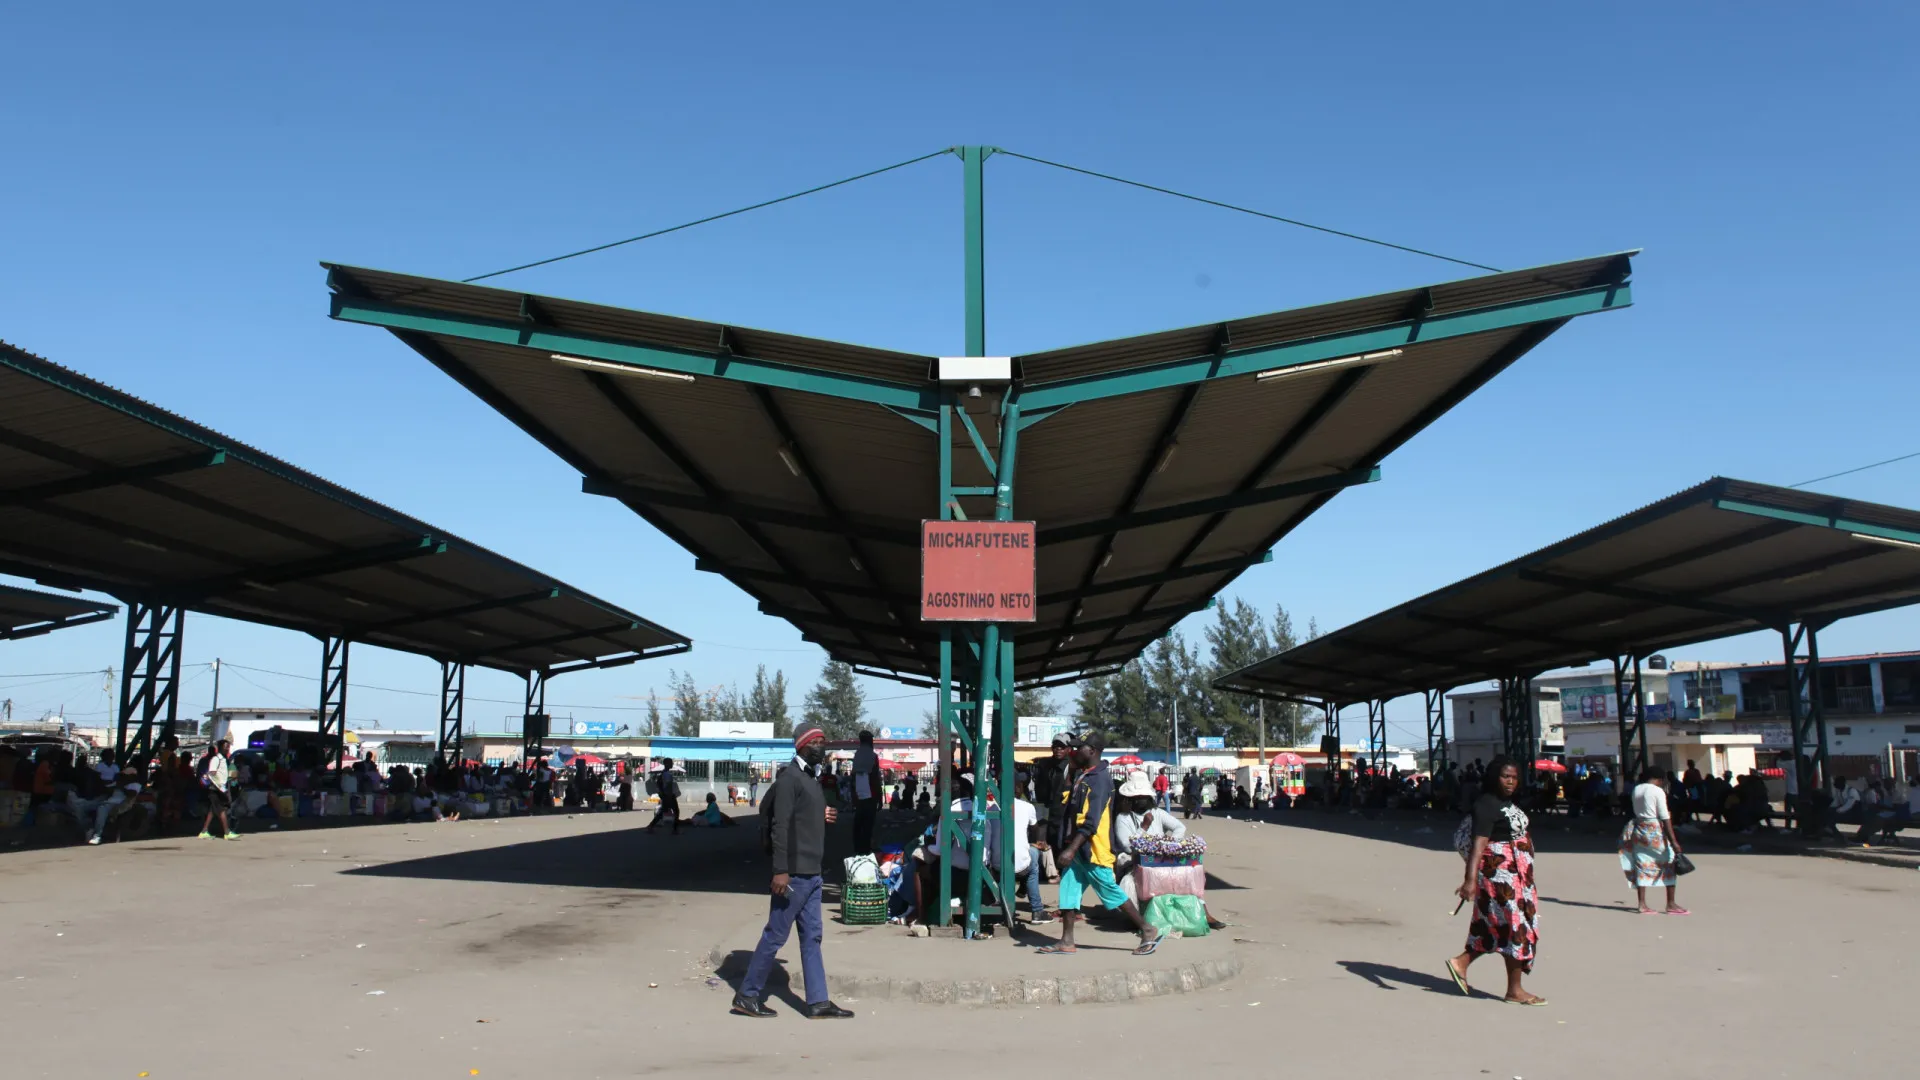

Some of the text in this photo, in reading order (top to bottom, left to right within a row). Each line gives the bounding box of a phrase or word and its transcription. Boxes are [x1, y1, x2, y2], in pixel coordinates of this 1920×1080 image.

[928, 532, 1029, 548] MICHAFUTENE
[926, 592, 1031, 608] AGOSTINHO NETO
